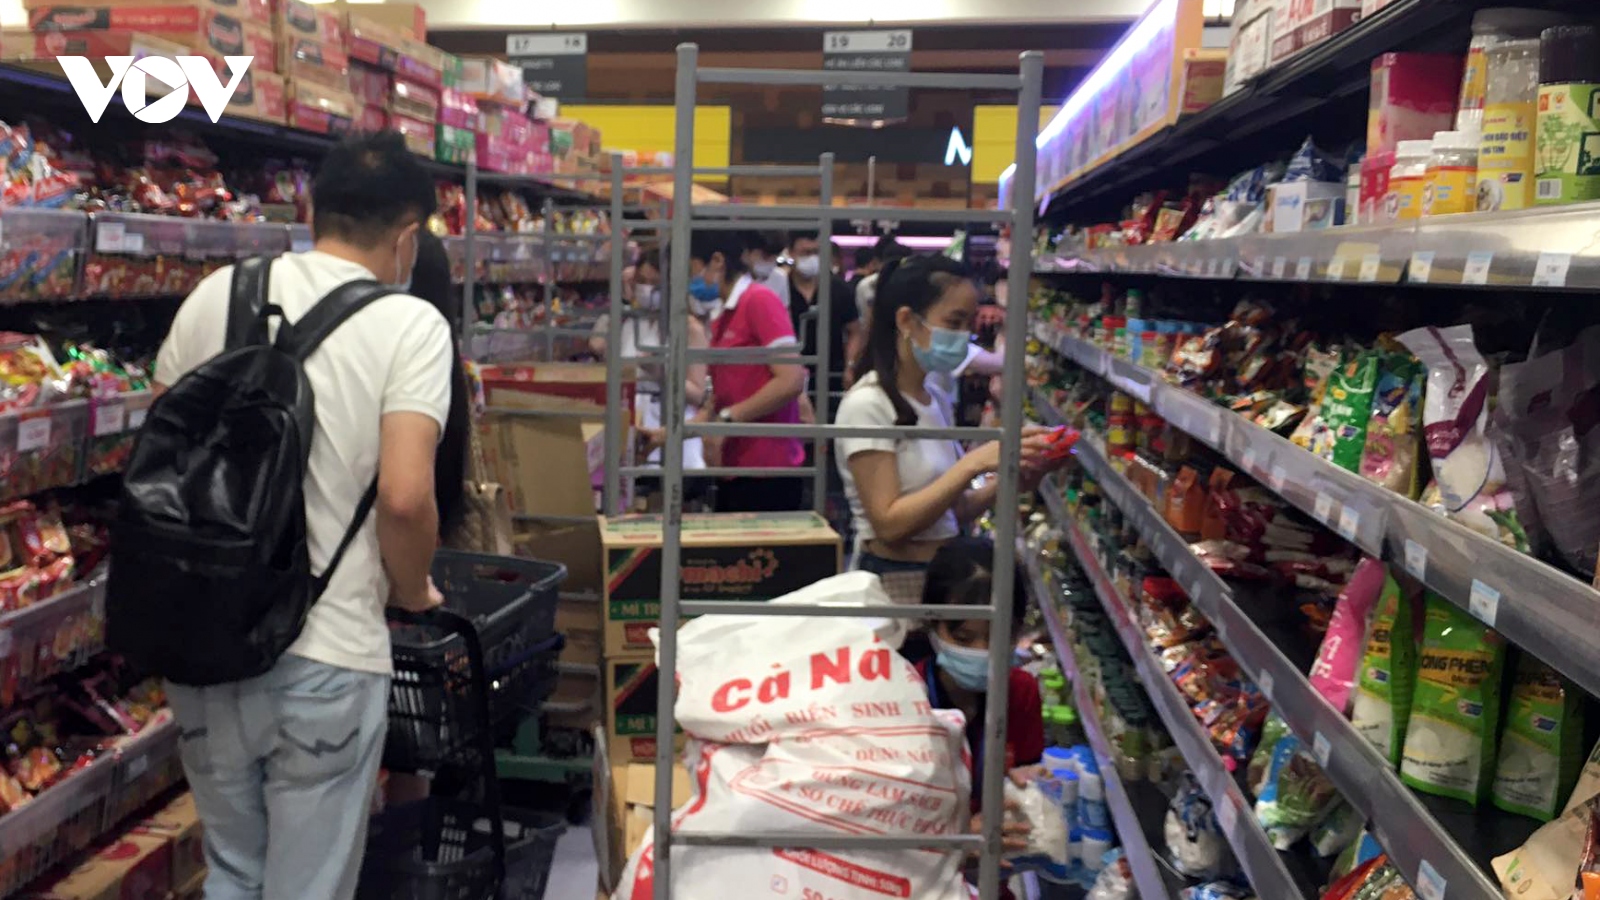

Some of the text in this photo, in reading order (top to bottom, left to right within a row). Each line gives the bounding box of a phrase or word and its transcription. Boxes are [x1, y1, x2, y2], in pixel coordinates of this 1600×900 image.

[830, 34, 907, 48] 19 20
[851, 701, 901, 718] SINH
